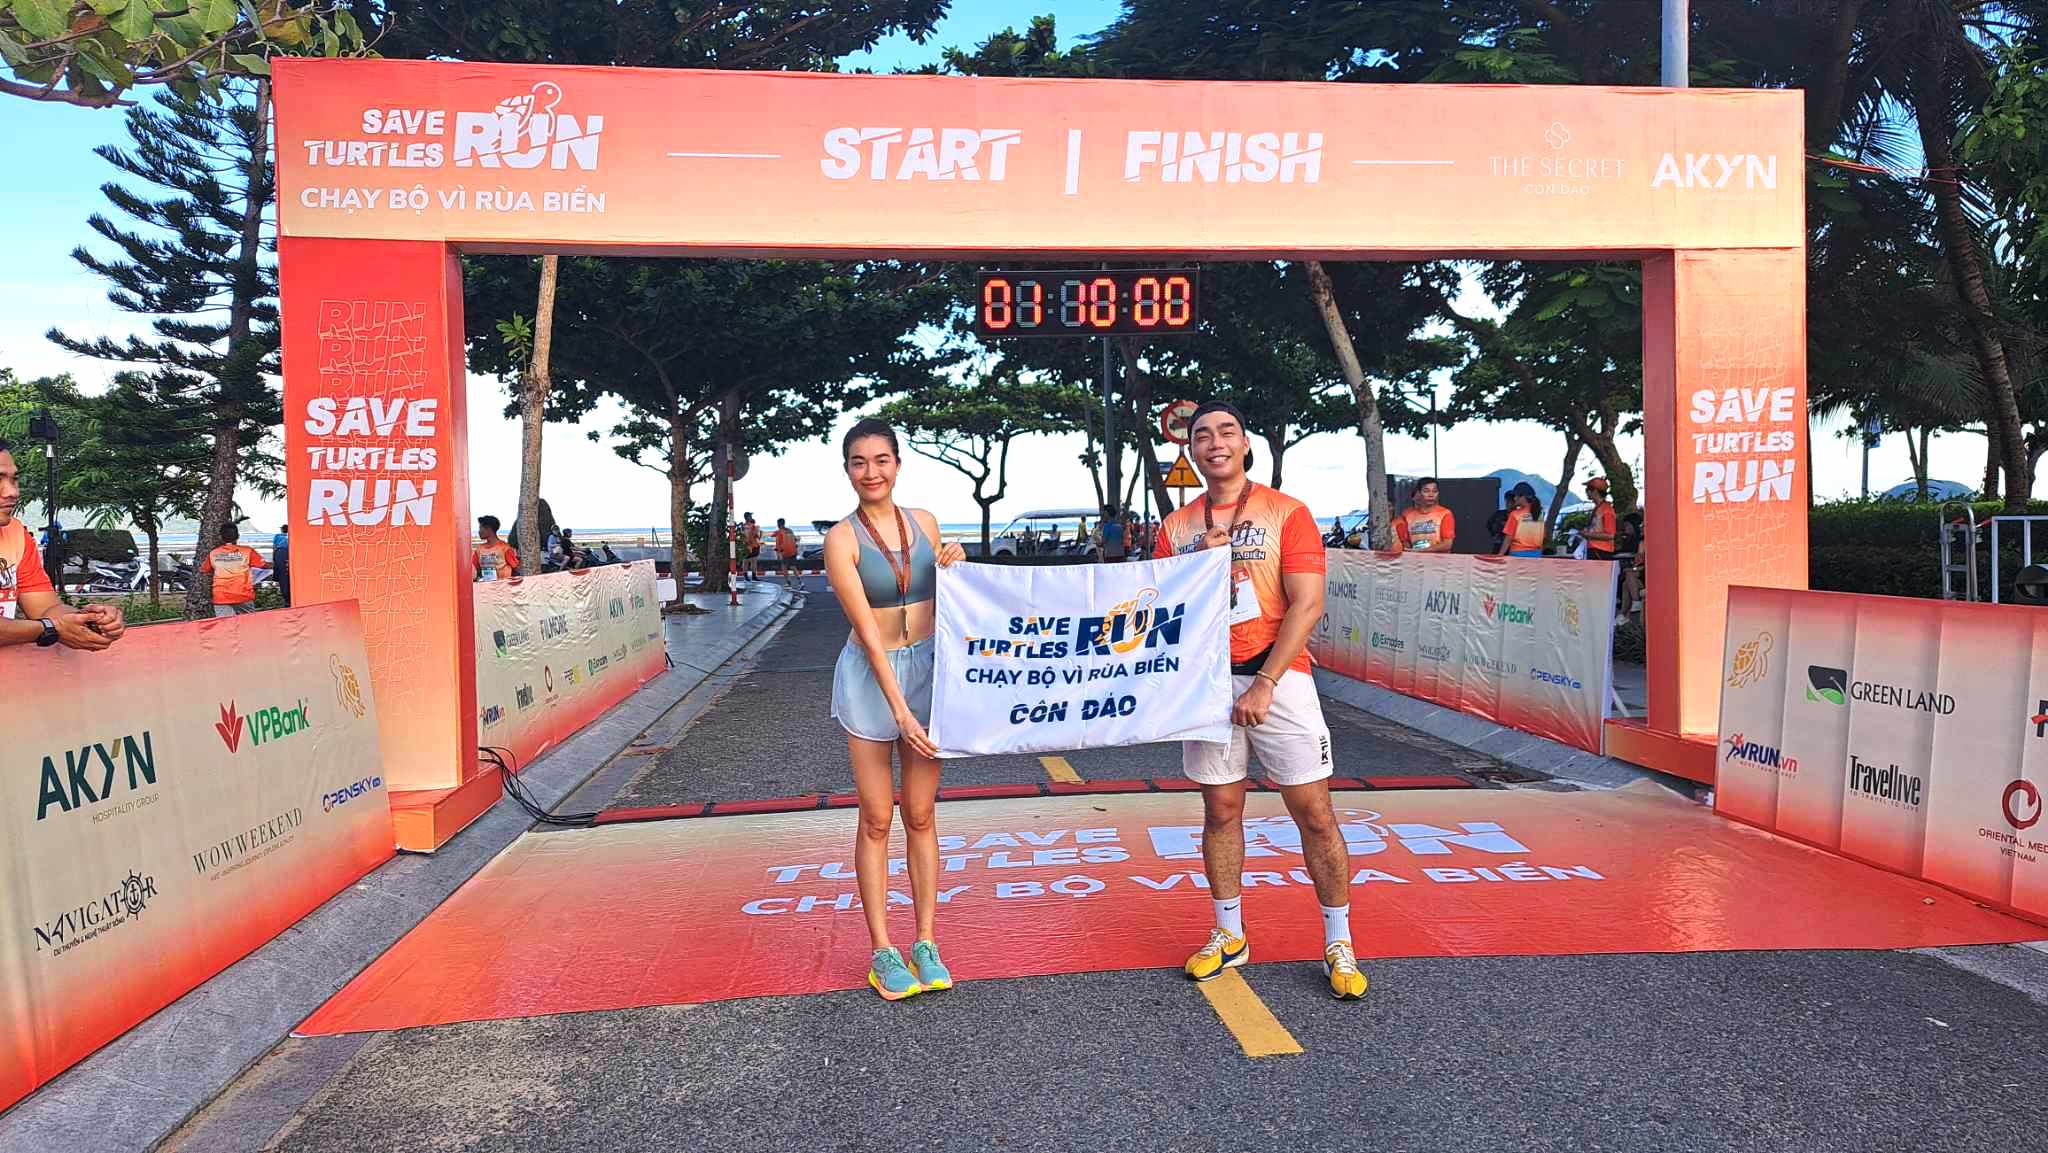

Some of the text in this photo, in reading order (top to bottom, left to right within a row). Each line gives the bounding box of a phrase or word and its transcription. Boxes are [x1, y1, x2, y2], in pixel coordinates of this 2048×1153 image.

[362, 109, 446, 136] SAVE
[303, 140, 445, 168] TURTLES
[454, 112, 604, 170] RUN
[820, 127, 1022, 181] START
[1124, 131, 1325, 183] FINISH
[1488, 156, 1625, 178] THE SECRET
[1650, 152, 1777, 189] AKYN
[301, 183, 606, 215] CHẠY BỘ VÌ RÙA BIỂN
[318, 300, 427, 338] RUN
[318, 336, 427, 373] RUN
[304, 397, 438, 437] SAVE
[1690, 387, 1796, 424] SAVE
[306, 446, 438, 471] TURTLES
[1692, 431, 1795, 454] TURTLES
[1692, 458, 1796, 504] RUN
[306, 479, 438, 526] RUN
[1425, 591, 1460, 616] AKYN
[1496, 603, 1535, 625] VPBank
[1009, 616, 1070, 636] SAVE
[1075, 602, 1185, 656] RUN
[964, 636, 1069, 659] TURTLES
[965, 668, 1022, 688] CHẠY
[1027, 666, 1056, 688] BỘ
[1062, 665, 1083, 684] VÌ
[1010, 700, 1069, 725] CÔN
[1850, 681, 1956, 715] GREEN LAND
[246, 699, 310, 746] VPBank
[1740, 741, 1798, 773] VRUN.vn
[37, 731, 157, 821] AKYN
[1850, 755, 1921, 806] Travellive
[322, 776, 373, 813] OPENSKY
[92, 801, 136, 825] HOSPITALITY
[1978, 828, 2024, 848] ORIENTAL
[2000, 847, 2036, 864] VIETNAM
[996, 874, 1106, 899] BỘ
